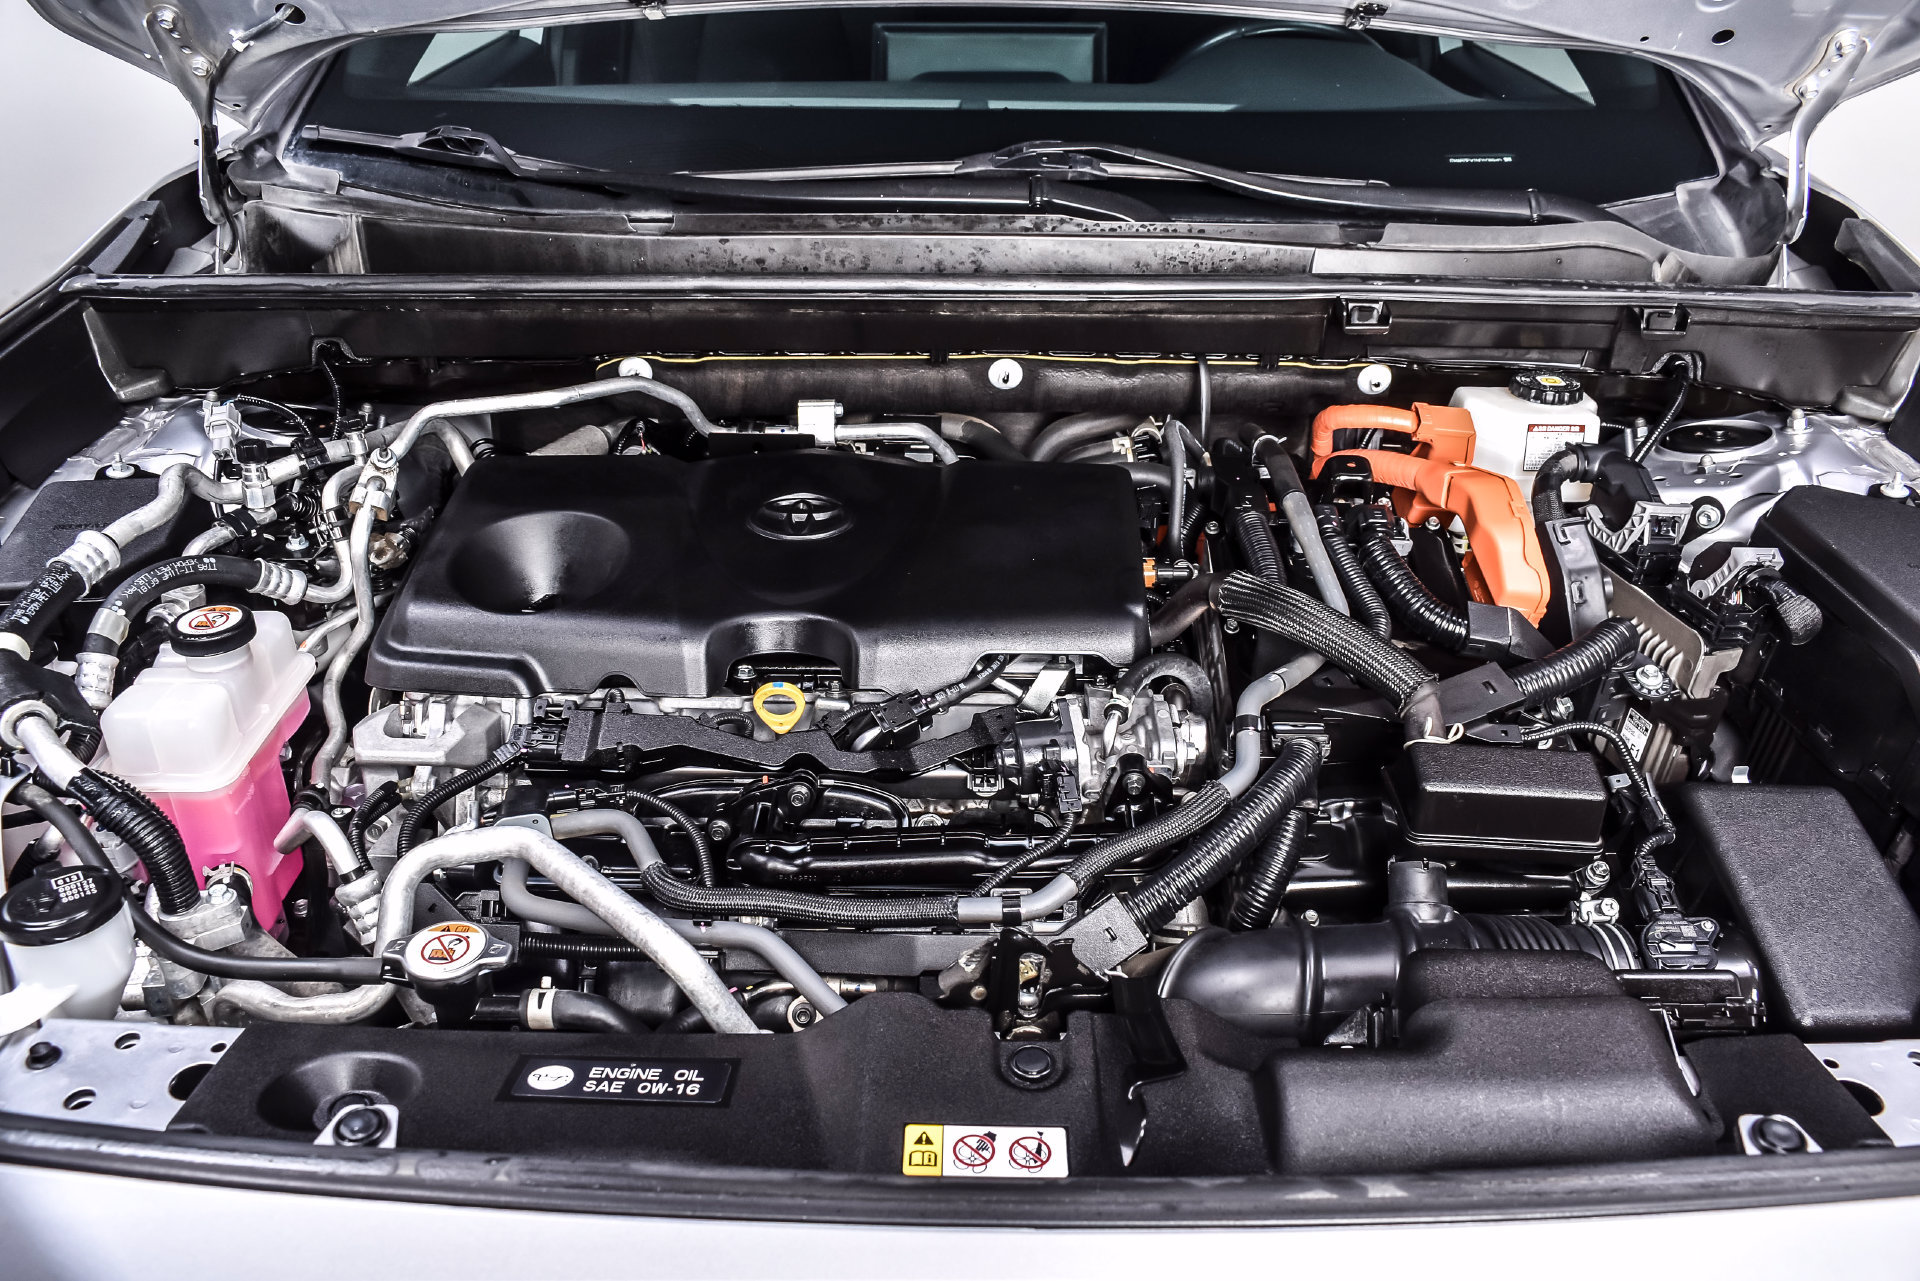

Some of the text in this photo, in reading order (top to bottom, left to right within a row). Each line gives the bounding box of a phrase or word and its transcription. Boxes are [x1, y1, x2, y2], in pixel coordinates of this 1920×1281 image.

[588, 1067, 704, 1081] ENGINE OIL
[583, 1080, 700, 1096] SAE 0W-16
